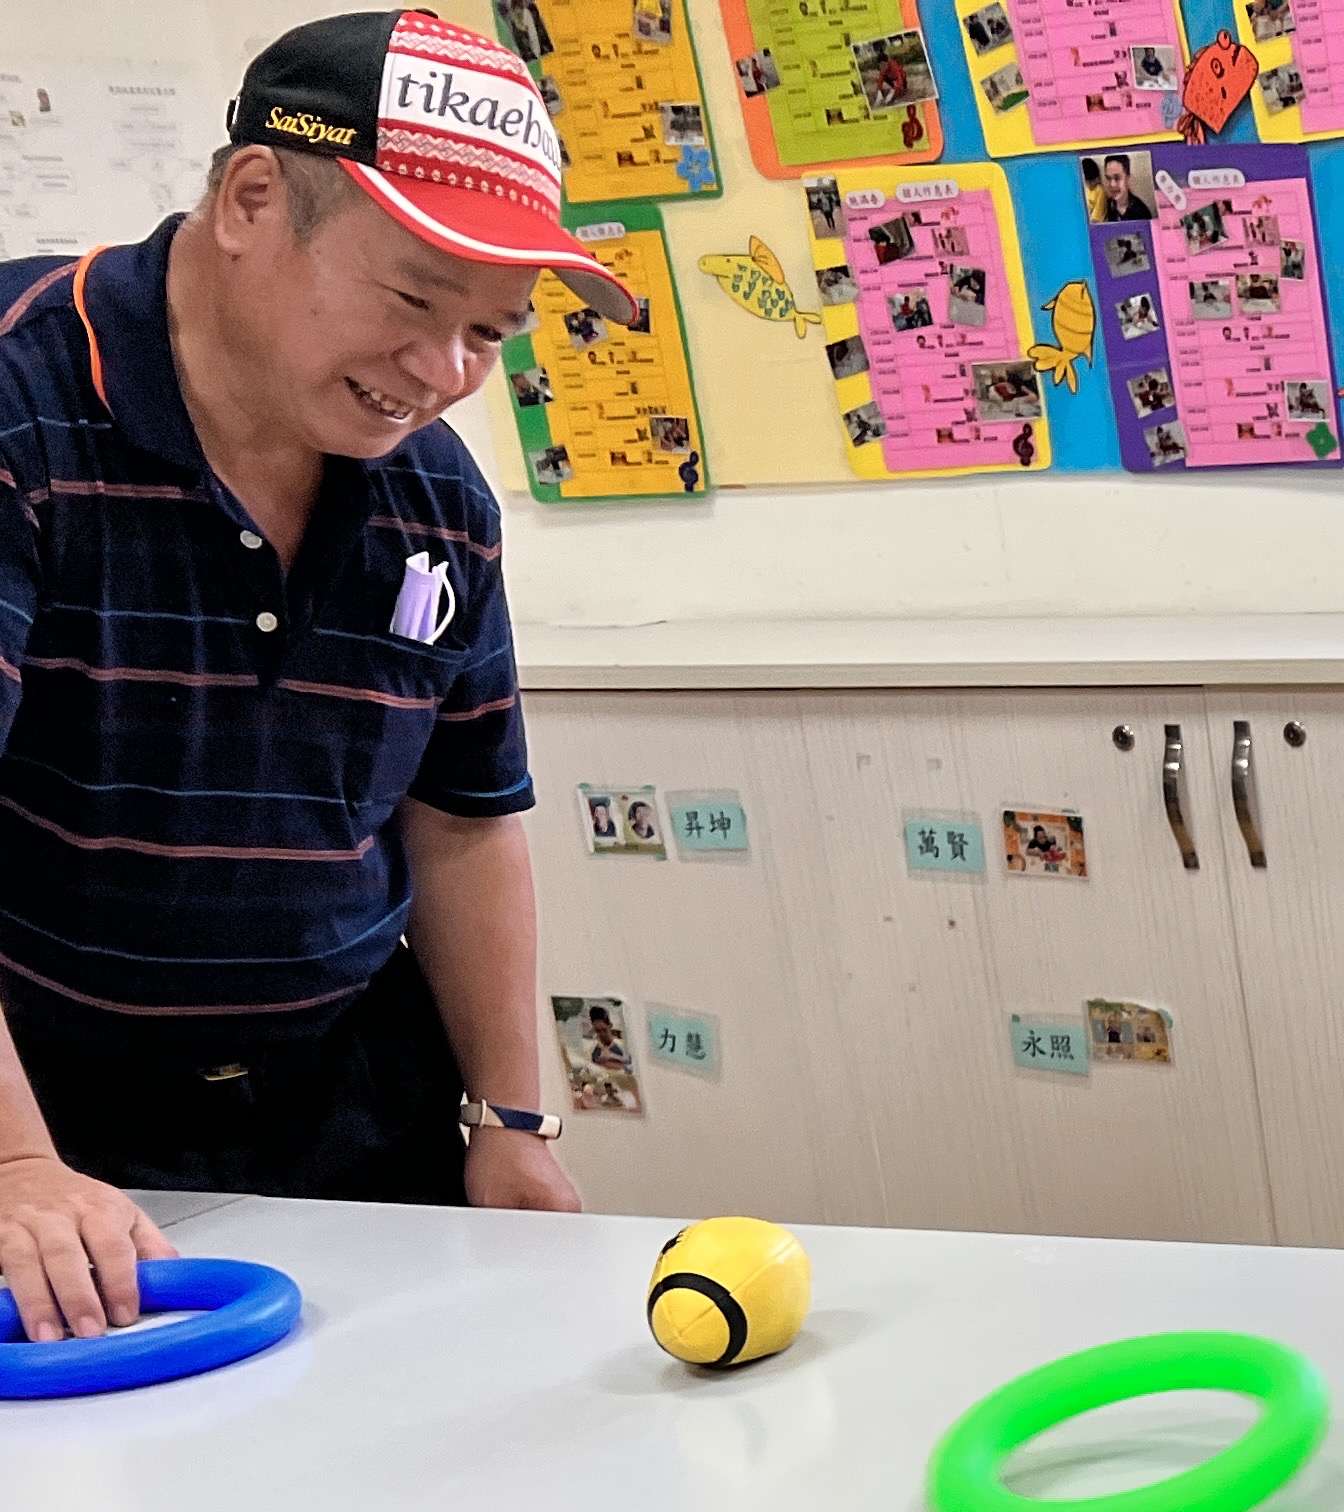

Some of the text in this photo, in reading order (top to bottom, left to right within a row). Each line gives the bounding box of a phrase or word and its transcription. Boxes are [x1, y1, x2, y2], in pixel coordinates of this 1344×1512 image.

[265, 106, 357, 145] SaiSiyat
[918, 827, 969, 862] 萬賢
[1021, 1029, 1075, 1061] 永照
